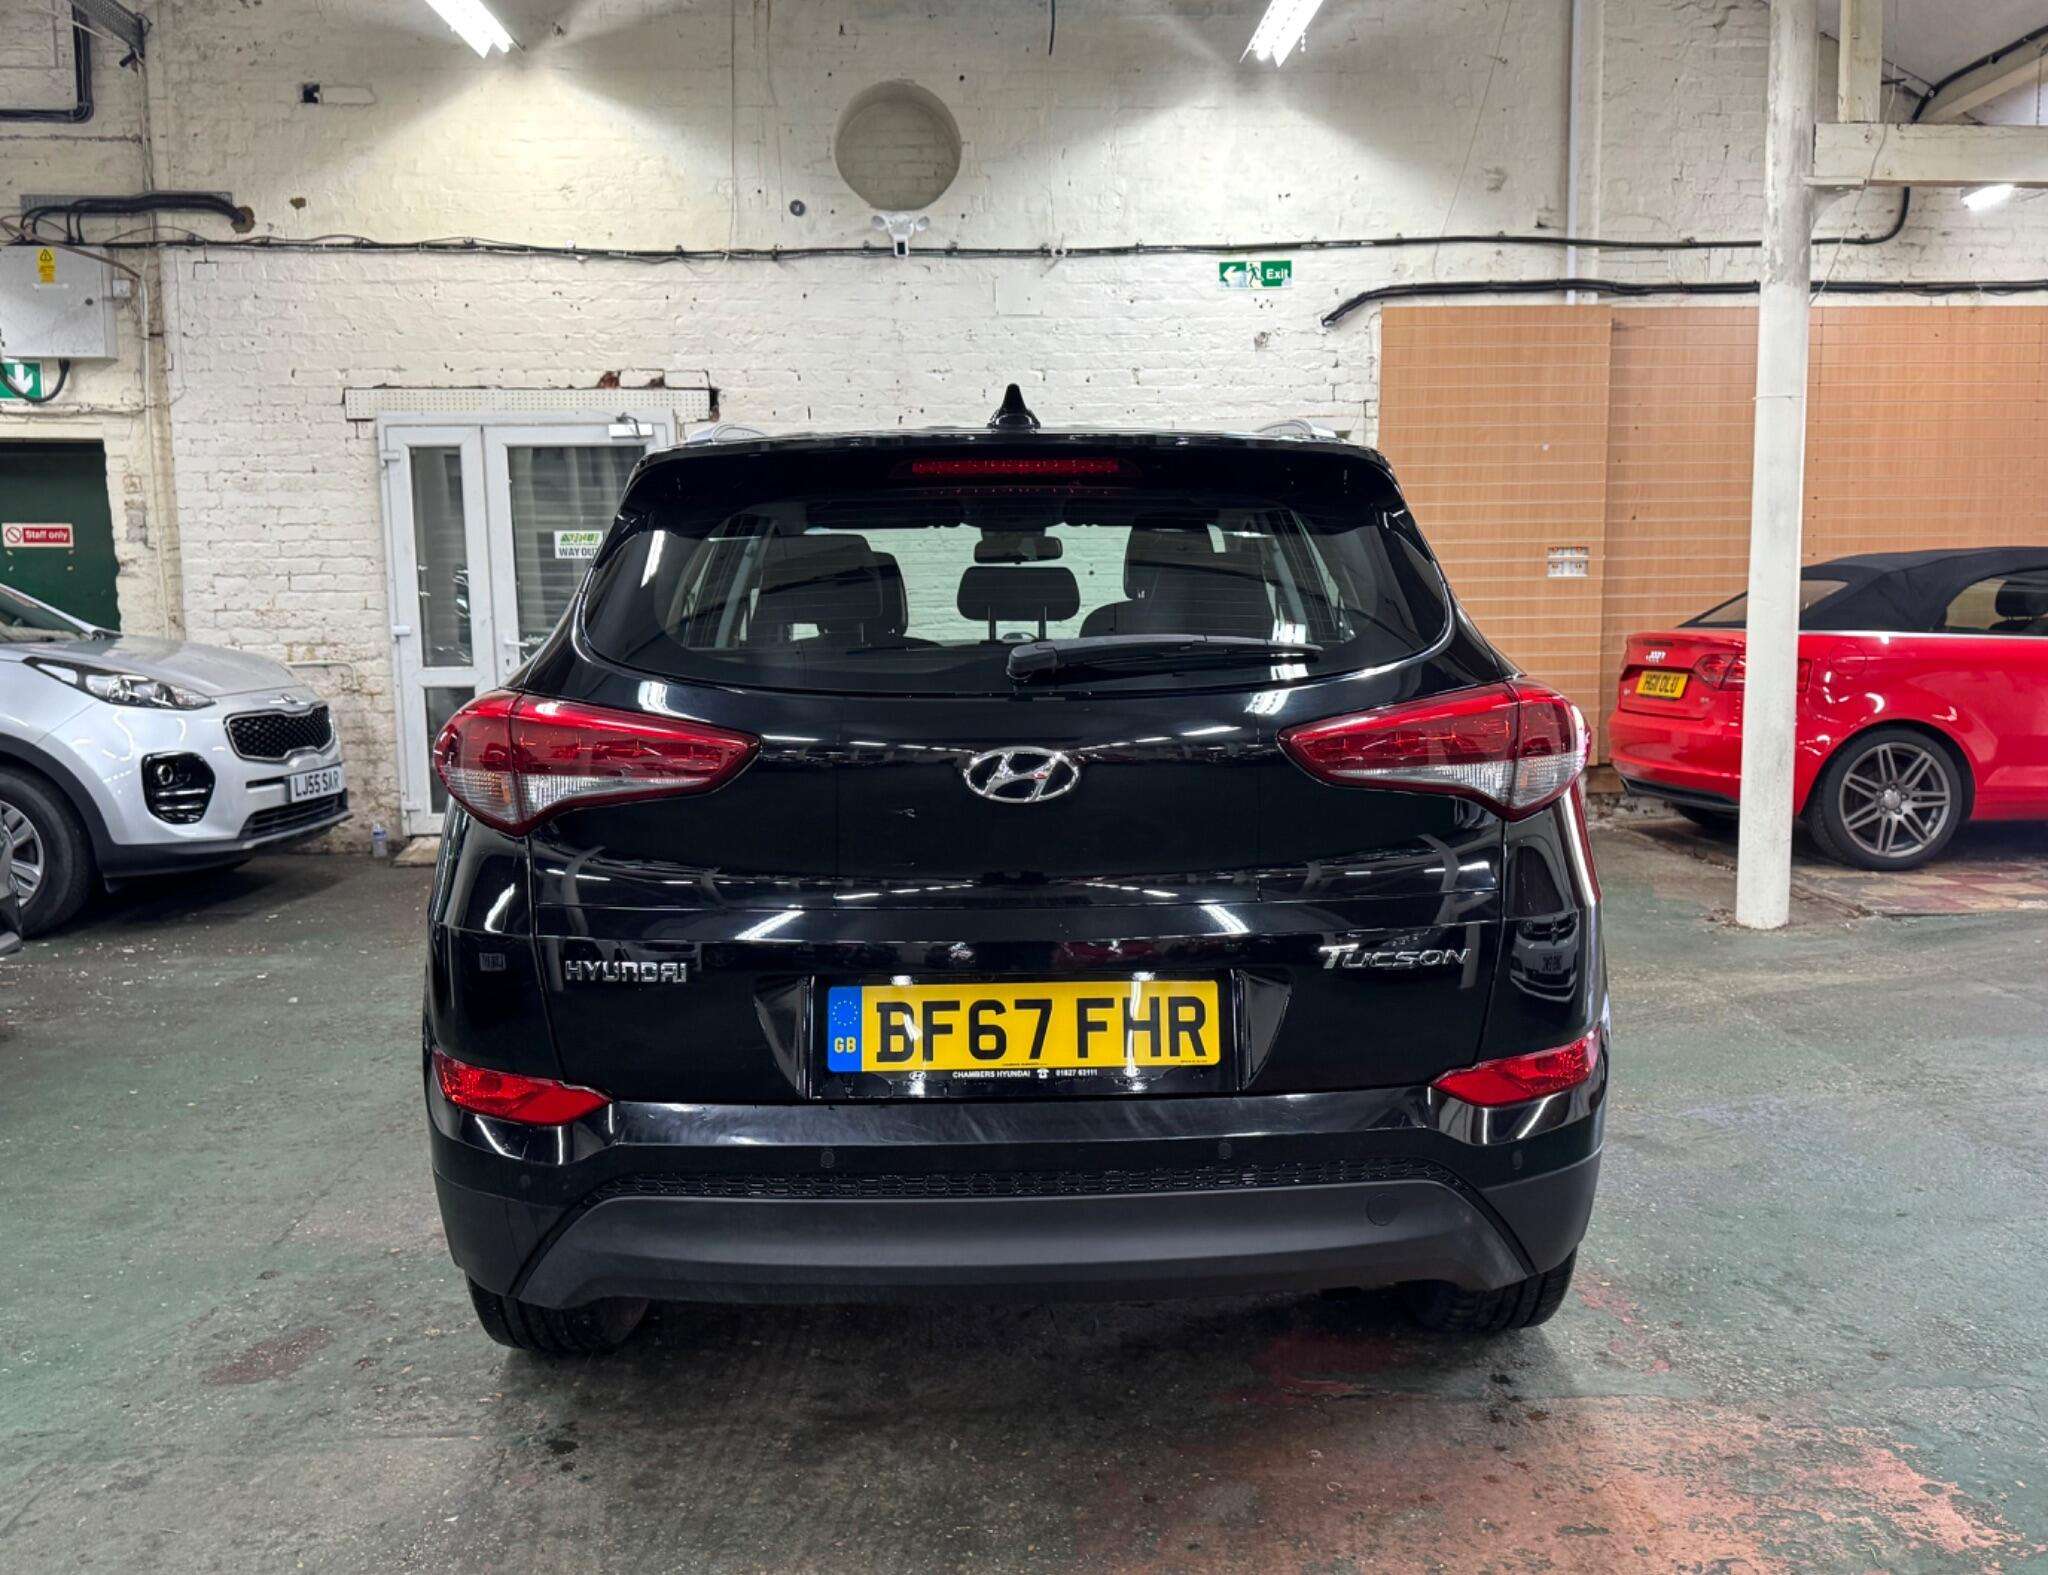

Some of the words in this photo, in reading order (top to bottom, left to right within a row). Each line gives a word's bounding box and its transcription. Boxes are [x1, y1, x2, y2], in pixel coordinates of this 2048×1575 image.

[1266, 267, 1289, 280] Exit
[24, 529, 47, 539] Staff
[48, 529, 68, 541] only
[559, 547, 579, 556] WAY
[294, 773, 321, 797] LJ55
[1318, 943, 1472, 969] TUCSON
[565, 960, 687, 983] HYUNDAI
[876, 998, 1053, 1063] BF67
[1076, 996, 1207, 1059] FHR
[834, 1036, 857, 1054] GB
[952, 1070, 995, 1079] CHAMBERS
[996, 1070, 1031, 1078] HYUNDAI
